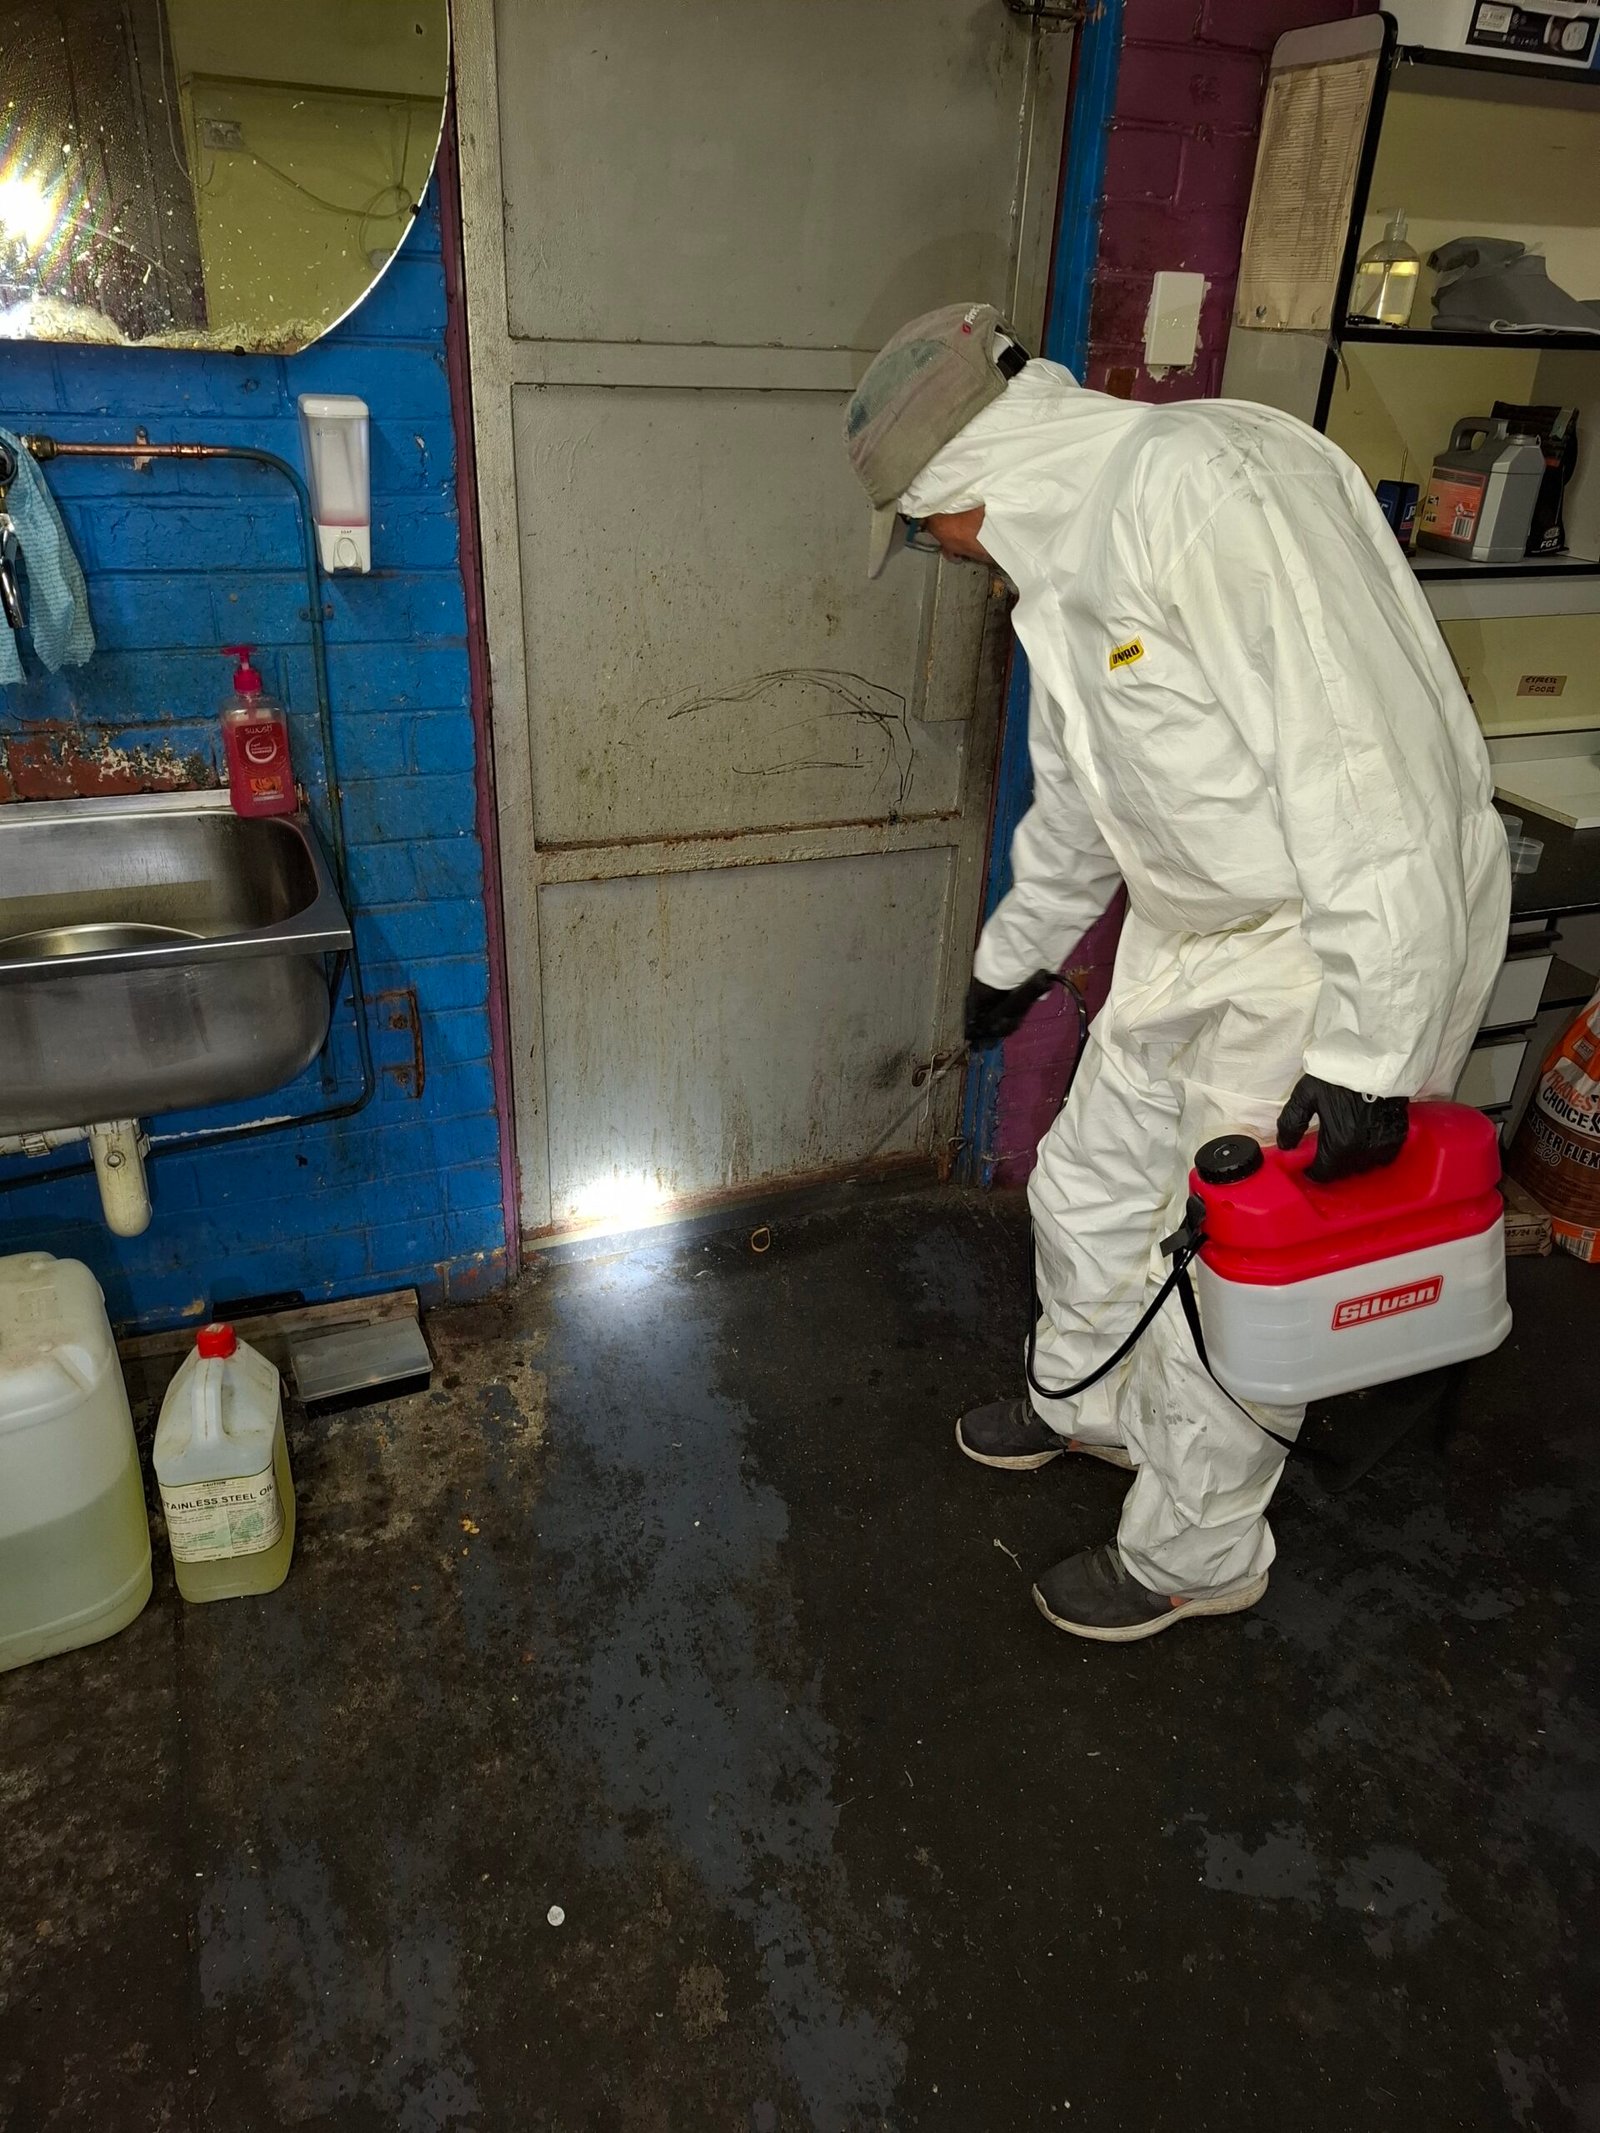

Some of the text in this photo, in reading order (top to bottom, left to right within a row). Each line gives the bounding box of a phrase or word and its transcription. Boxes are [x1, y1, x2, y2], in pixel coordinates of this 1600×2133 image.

[1542, 1086, 1590, 1129] CHOICE
[1535, 1139, 1562, 1167] ECO
[1563, 1141, 1600, 1170] FLEX
[221, 1492, 257, 1504] STEEL
[259, 1483, 274, 1496] OIL
